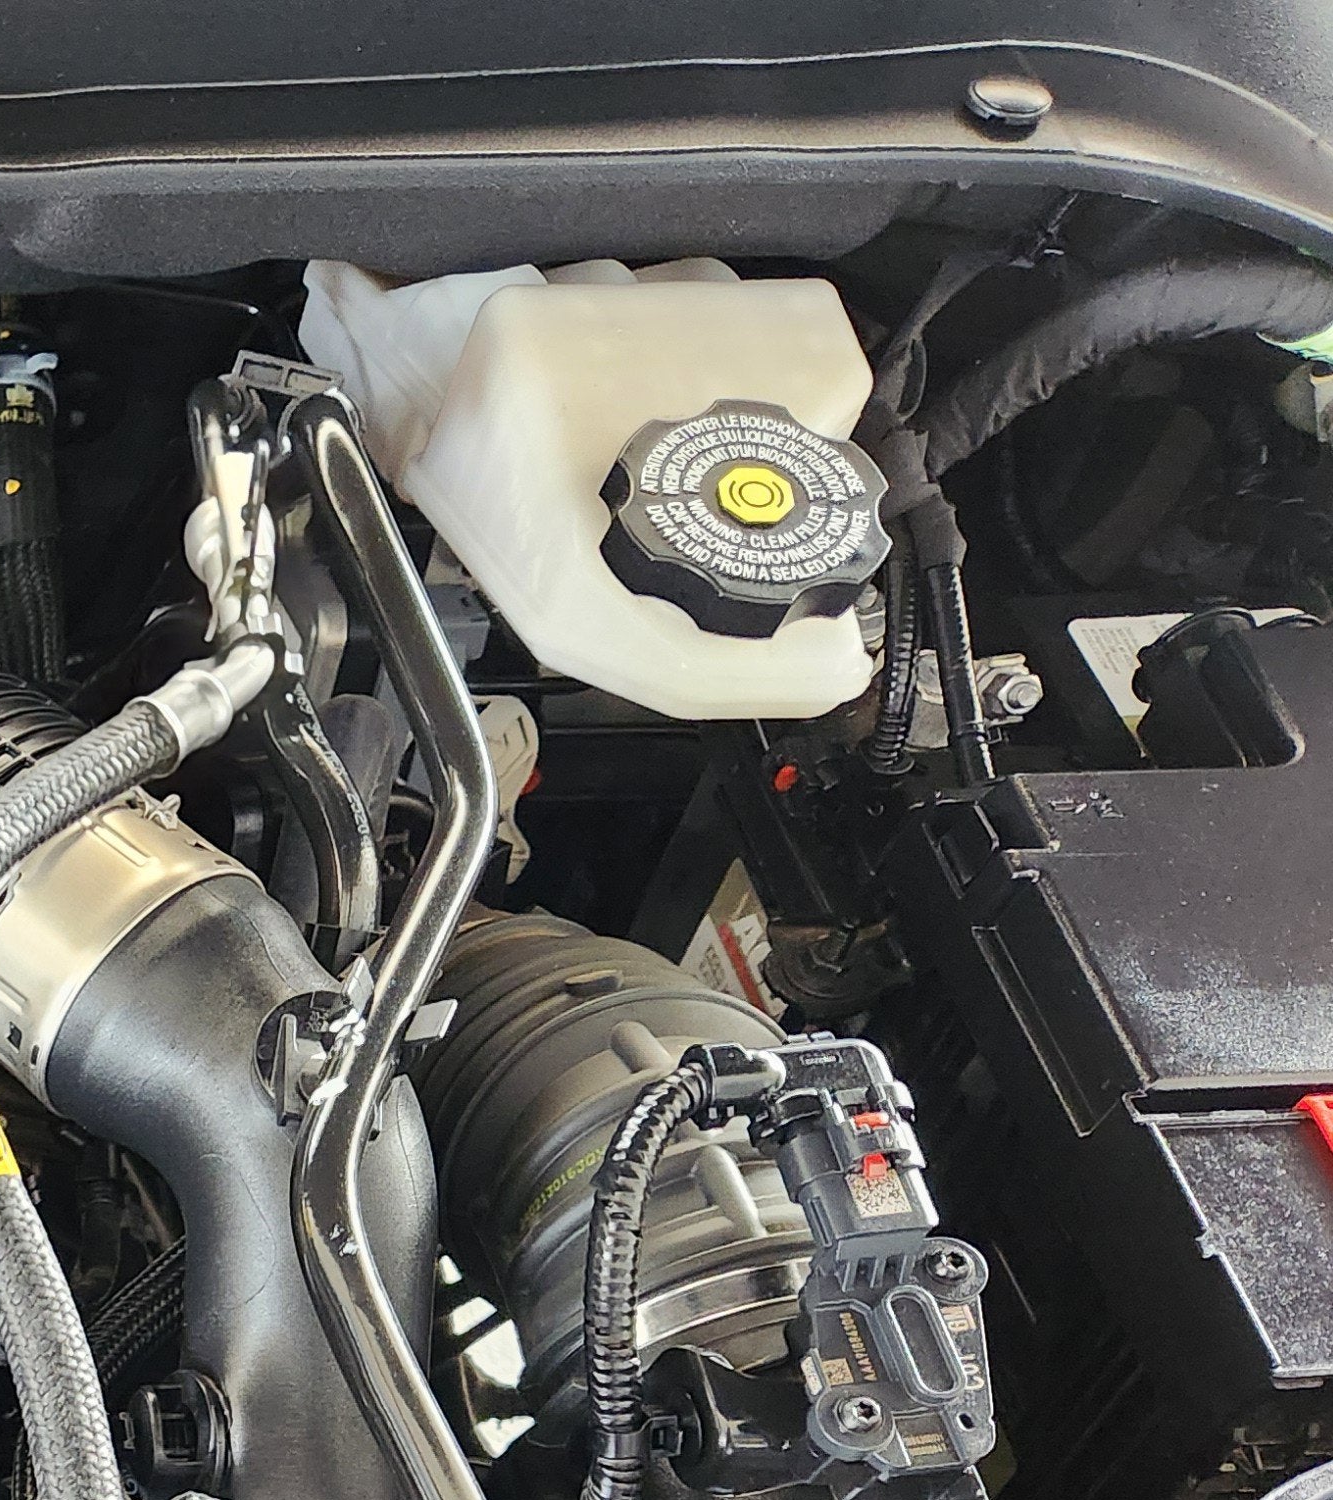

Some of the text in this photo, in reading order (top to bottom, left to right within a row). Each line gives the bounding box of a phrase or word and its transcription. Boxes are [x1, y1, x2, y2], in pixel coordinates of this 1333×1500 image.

[663, 416, 722, 448] NETTOYER
[721, 414, 740, 428] LE
[740, 415, 801, 440] BOUCHON
[797, 431, 840, 460] AVANT
[694, 432, 722, 453] QUE
[718, 429, 737, 445] DU
[737, 429, 786, 450] LIQUIDE
[782, 440, 804, 457] DE
[797, 449, 834, 479] FREIN
[683, 445, 730, 494] PROVENANT
[757, 446, 795, 470] BIDON
[789, 460, 827, 501] SCELLE
[645, 504, 675, 530] DOT
[668, 531, 712, 564] FLUID
[710, 554, 757, 580] FROM
[758, 566, 771, 581] A
[769, 558, 828, 582] SEALED
[823, 509, 871, 569] CONTAINER
[666, 501, 693, 525] CAP
[683, 521, 739, 559] BEFORE
[807, 532, 837, 555] USE
[825, 507, 849, 537] ONLY
[687, 498, 828, 549] WARNING: CLEAN FILLER
